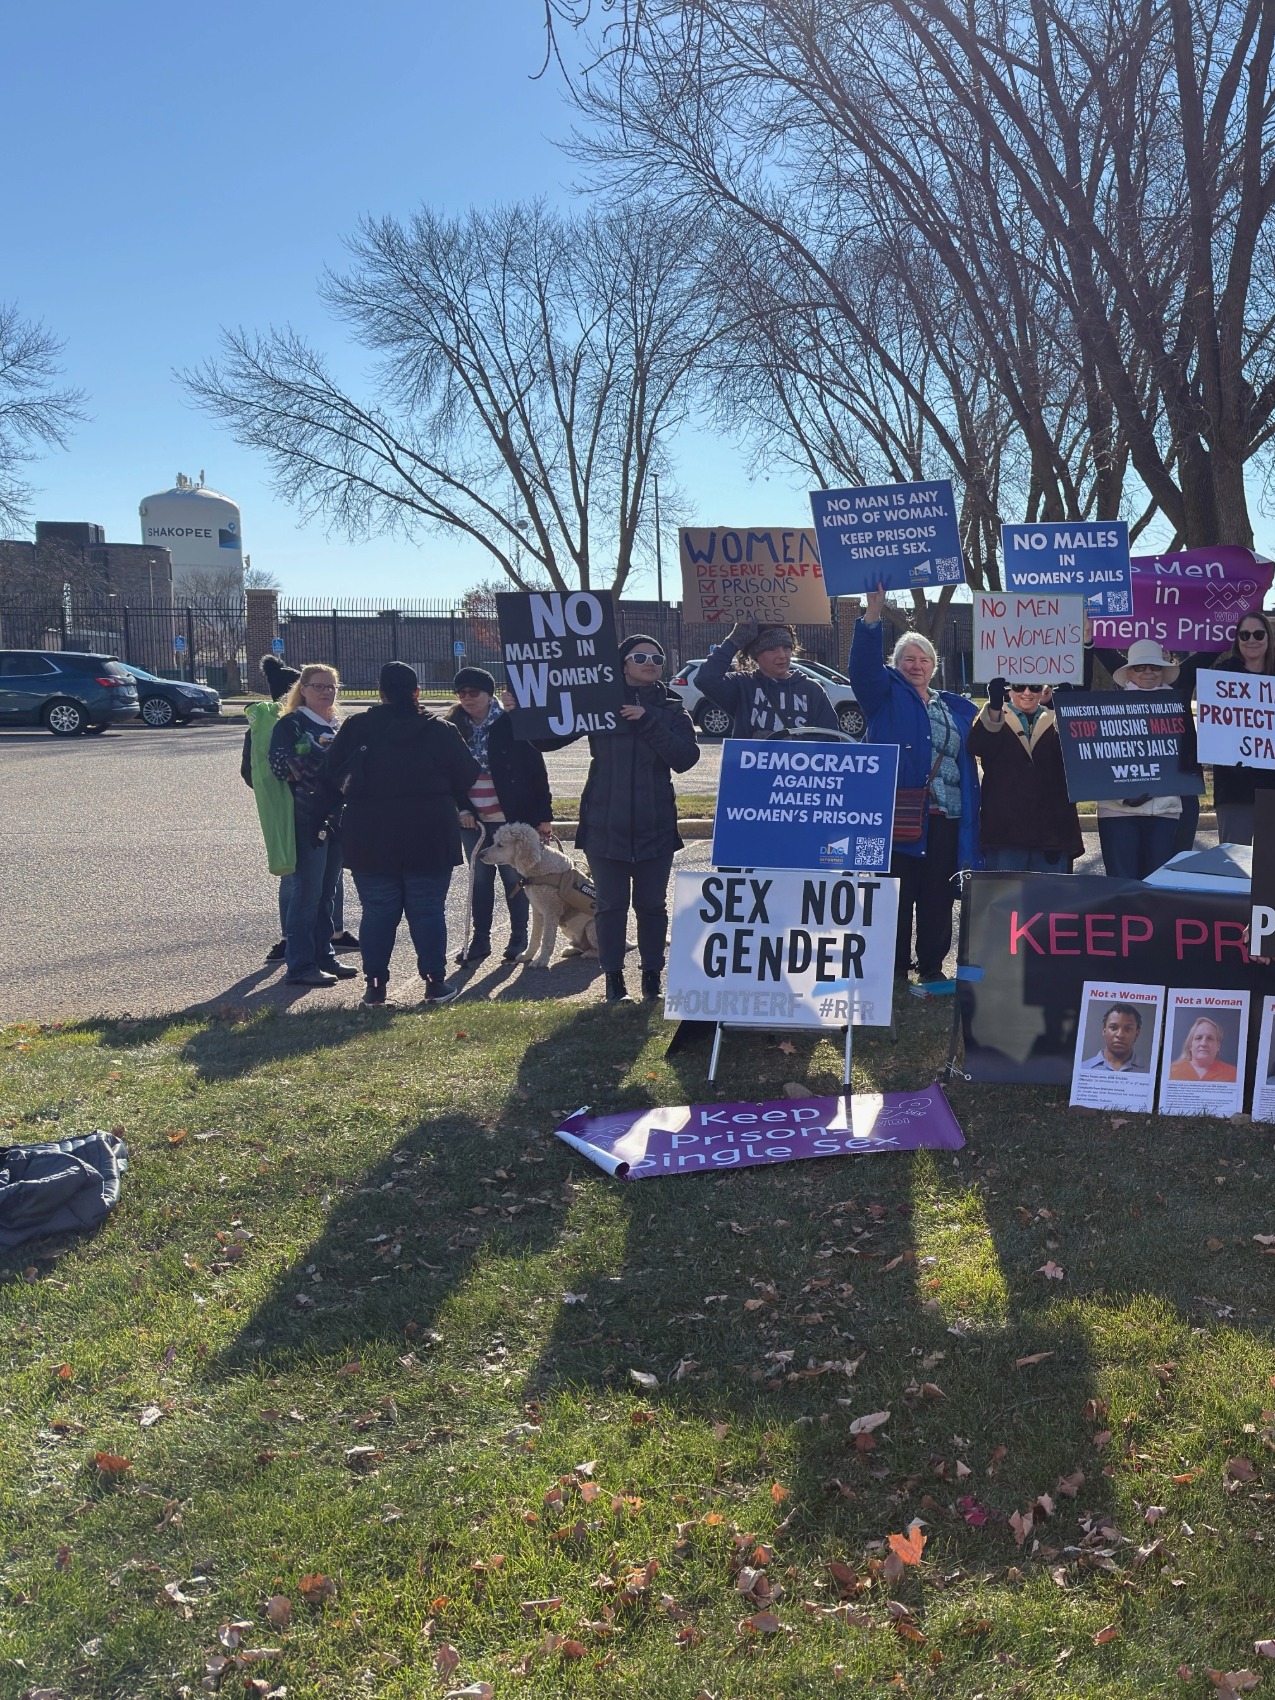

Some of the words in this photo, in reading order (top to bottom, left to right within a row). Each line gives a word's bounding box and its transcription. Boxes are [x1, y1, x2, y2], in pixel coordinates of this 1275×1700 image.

[827, 498, 850, 512] NO
[855, 495, 889, 509] MAN
[892, 493, 905, 506] IS
[909, 490, 938, 505] ANY
[823, 514, 858, 527] KIND
[862, 512, 881, 524] OF
[884, 506, 948, 522] WOMAN.
[147, 528, 212, 538] SHAKOPEE
[840, 531, 873, 546] KEEP
[877, 526, 936, 542] PRISONS
[1013, 533, 1047, 550] NO
[1054, 530, 1119, 549] MALES
[684, 532, 821, 564] WOMEN
[850, 546, 899, 560] SINGLE
[902, 542, 931, 555] SEX.
[1059, 554, 1075, 566] IN
[1154, 561, 1225, 579] Men
[696, 564, 765, 578] DESERVE
[775, 564, 823, 578] SAFE
[1012, 571, 1084, 585] WOMEN'S
[1087, 570, 1123, 583] JAILS
[722, 577, 798, 594] PRISONS
[1155, 580, 1180, 605] in
[723, 595, 790, 608] SPORTS
[982, 598, 1006, 618] NO
[1017, 598, 1058, 617] MEN
[529, 592, 603, 638] NO
[723, 609, 785, 622] SPACES
[981, 630, 995, 650] IN
[1003, 624, 1080, 648] WOMEN'S
[1092, 618, 1167, 639] men's
[505, 641, 562, 661] MALES
[577, 639, 595, 656] IN
[997, 654, 1074, 675] PRISONS
[506, 662, 613, 708] WOMEN'S
[1215, 680, 1251, 699] SEX
[548, 692, 617, 735] JAILS
[1060, 705, 1100, 717] MINNESOTA
[1100, 704, 1125, 716] HUMAN
[1126, 703, 1150, 715] RIGHTS
[1150, 702, 1185, 714] VIOLATION:
[1200, 703, 1275, 730] PROTECT
[1069, 721, 1098, 738] STOP
[1100, 719, 1148, 737] HOUSING
[1149, 717, 1186, 734] MALES
[1078, 743, 1092, 760] IN
[1093, 740, 1145, 759] WOMEN'S
[1147, 739, 1179, 756] JAILS!
[740, 750, 880, 774] DEMOCRATS
[772, 774, 844, 790] AGAINST
[769, 792, 821, 806] MALES
[825, 794, 844, 807] IN
[726, 807, 808, 823] WOMEN'S
[812, 810, 883, 826] PRISONS
[699, 876, 773, 924] SEX
[801, 880, 881, 927] NOT
[1009, 911, 1154, 958] KEEP
[703, 928, 866, 983] GENDER
[666, 988, 804, 1018] #OURTERF
[1090, 989, 1109, 998] Not
[1119, 991, 1158, 1001] Woman
[1175, 996, 1195, 1005] Not
[1204, 998, 1243, 1006] Woman
[701, 1108, 820, 1126] Keep
[812, 1137, 900, 1154] Sex
